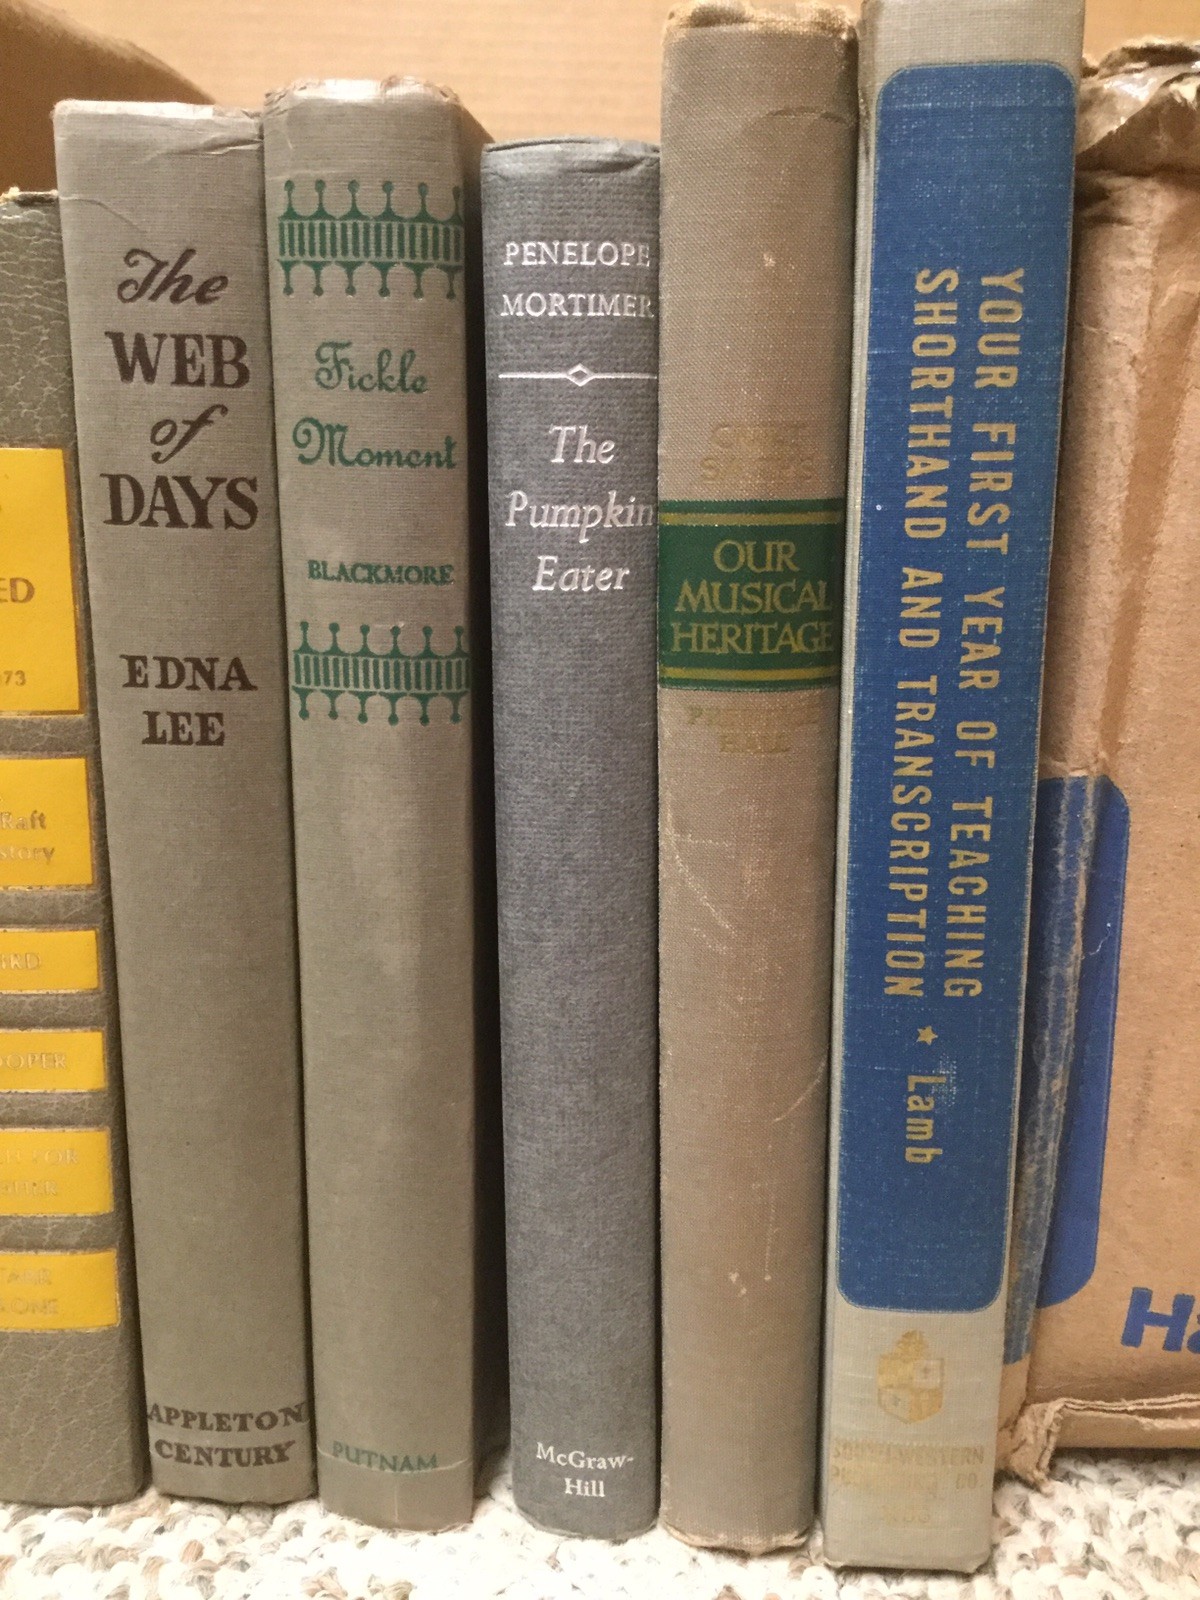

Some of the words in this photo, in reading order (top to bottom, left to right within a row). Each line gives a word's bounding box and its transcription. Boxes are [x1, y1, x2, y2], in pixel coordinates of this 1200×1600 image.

[503, 240, 650, 267] PENELOPE
[117, 249, 229, 306] The
[500, 291, 655, 318] MORTIMER
[974, 267, 1025, 389] YOUR
[105, 331, 250, 389] WEB
[315, 341, 429, 394] Fickle
[904, 268, 960, 539] SHORTHAND
[149, 404, 229, 464] of
[292, 417, 457, 469] Moment
[548, 423, 616, 464] The
[100, 473, 259, 530] DAYS
[966, 422, 1017, 555] FIRST
[505, 489, 654, 544] Pumpkin
[306, 559, 455, 586] BLACKMORE
[531, 554, 630, 592] Eater
[713, 539, 799, 573] OUR
[675, 579, 832, 615] MUSICAL
[898, 566, 944, 649] AND
[671, 621, 833, 656] HERITAGE
[958, 586, 1006, 690] YEAR
[0, 669, 27, 687] 73
[119, 654, 258, 692] EDNA
[142, 711, 226, 747] LEE
[955, 720, 998, 769] OF
[884, 674, 938, 997] TRANSCRIPTION
[943, 796, 993, 998] TEACHING
[0, 1052, 66, 1070] OPER
[904, 1074, 948, 1164] Lamb
[1120, 1286, 1200, 1354] H
[148, 1402, 309, 1433] APPLETON
[154, 1438, 297, 1468] CENTURY
[332, 1440, 440, 1473] PUTNAM
[535, 1441, 635, 1470] McGraw-
[563, 1477, 606, 1498] Hill
